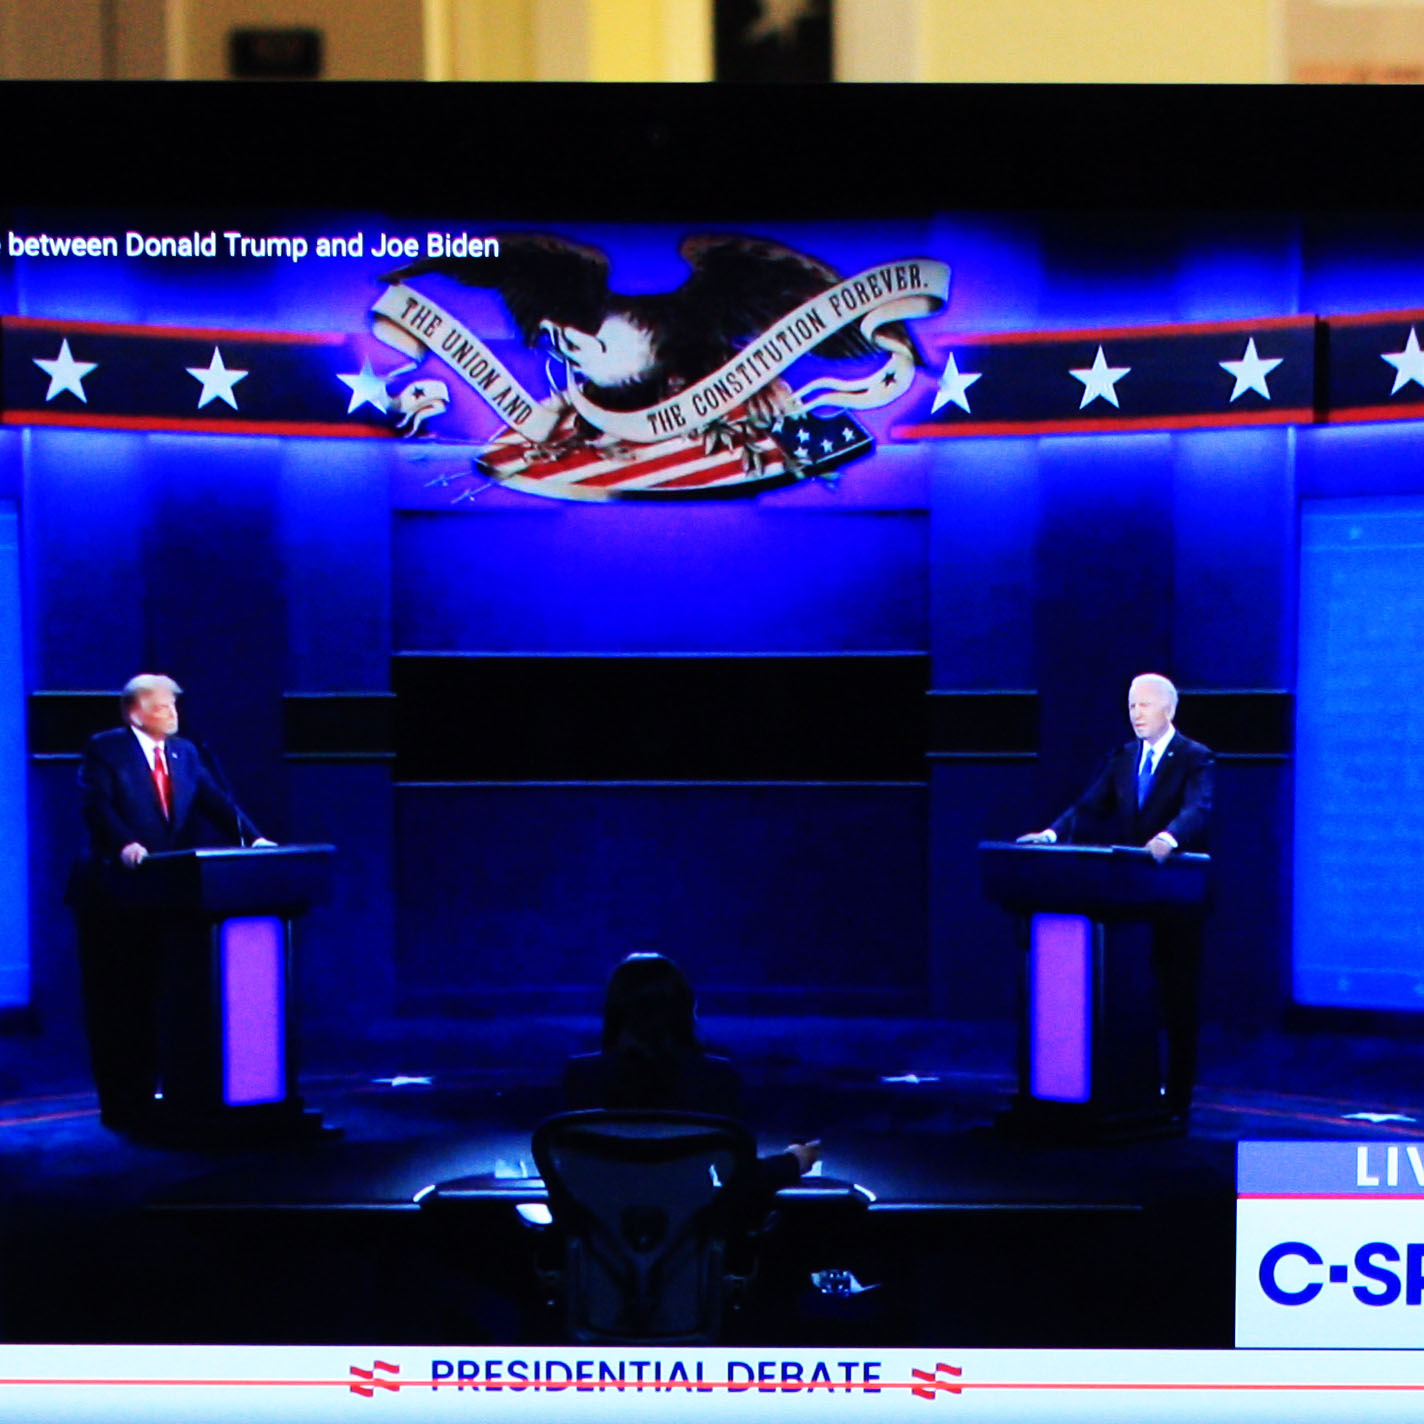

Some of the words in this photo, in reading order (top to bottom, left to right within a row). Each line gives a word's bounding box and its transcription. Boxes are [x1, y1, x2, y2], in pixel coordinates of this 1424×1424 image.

[8, 230, 119, 258] between
[126, 230, 216, 258] Donald
[222, 231, 309, 262] Trump
[316, 233, 365, 259] and
[372, 233, 421, 259] Joe
[427, 231, 499, 259] Biden
[399, 296, 437, 339] THE
[441, 328, 495, 389] UNION
[492, 373, 534, 427] AND
[647, 405, 689, 435] THE
[694, 316, 828, 417] CONSTITUTION
[829, 263, 930, 317] FOREVER.
[431, 1360, 712, 1394] PRESIDENTIAL
[727, 1361, 882, 1394] DEBATE
